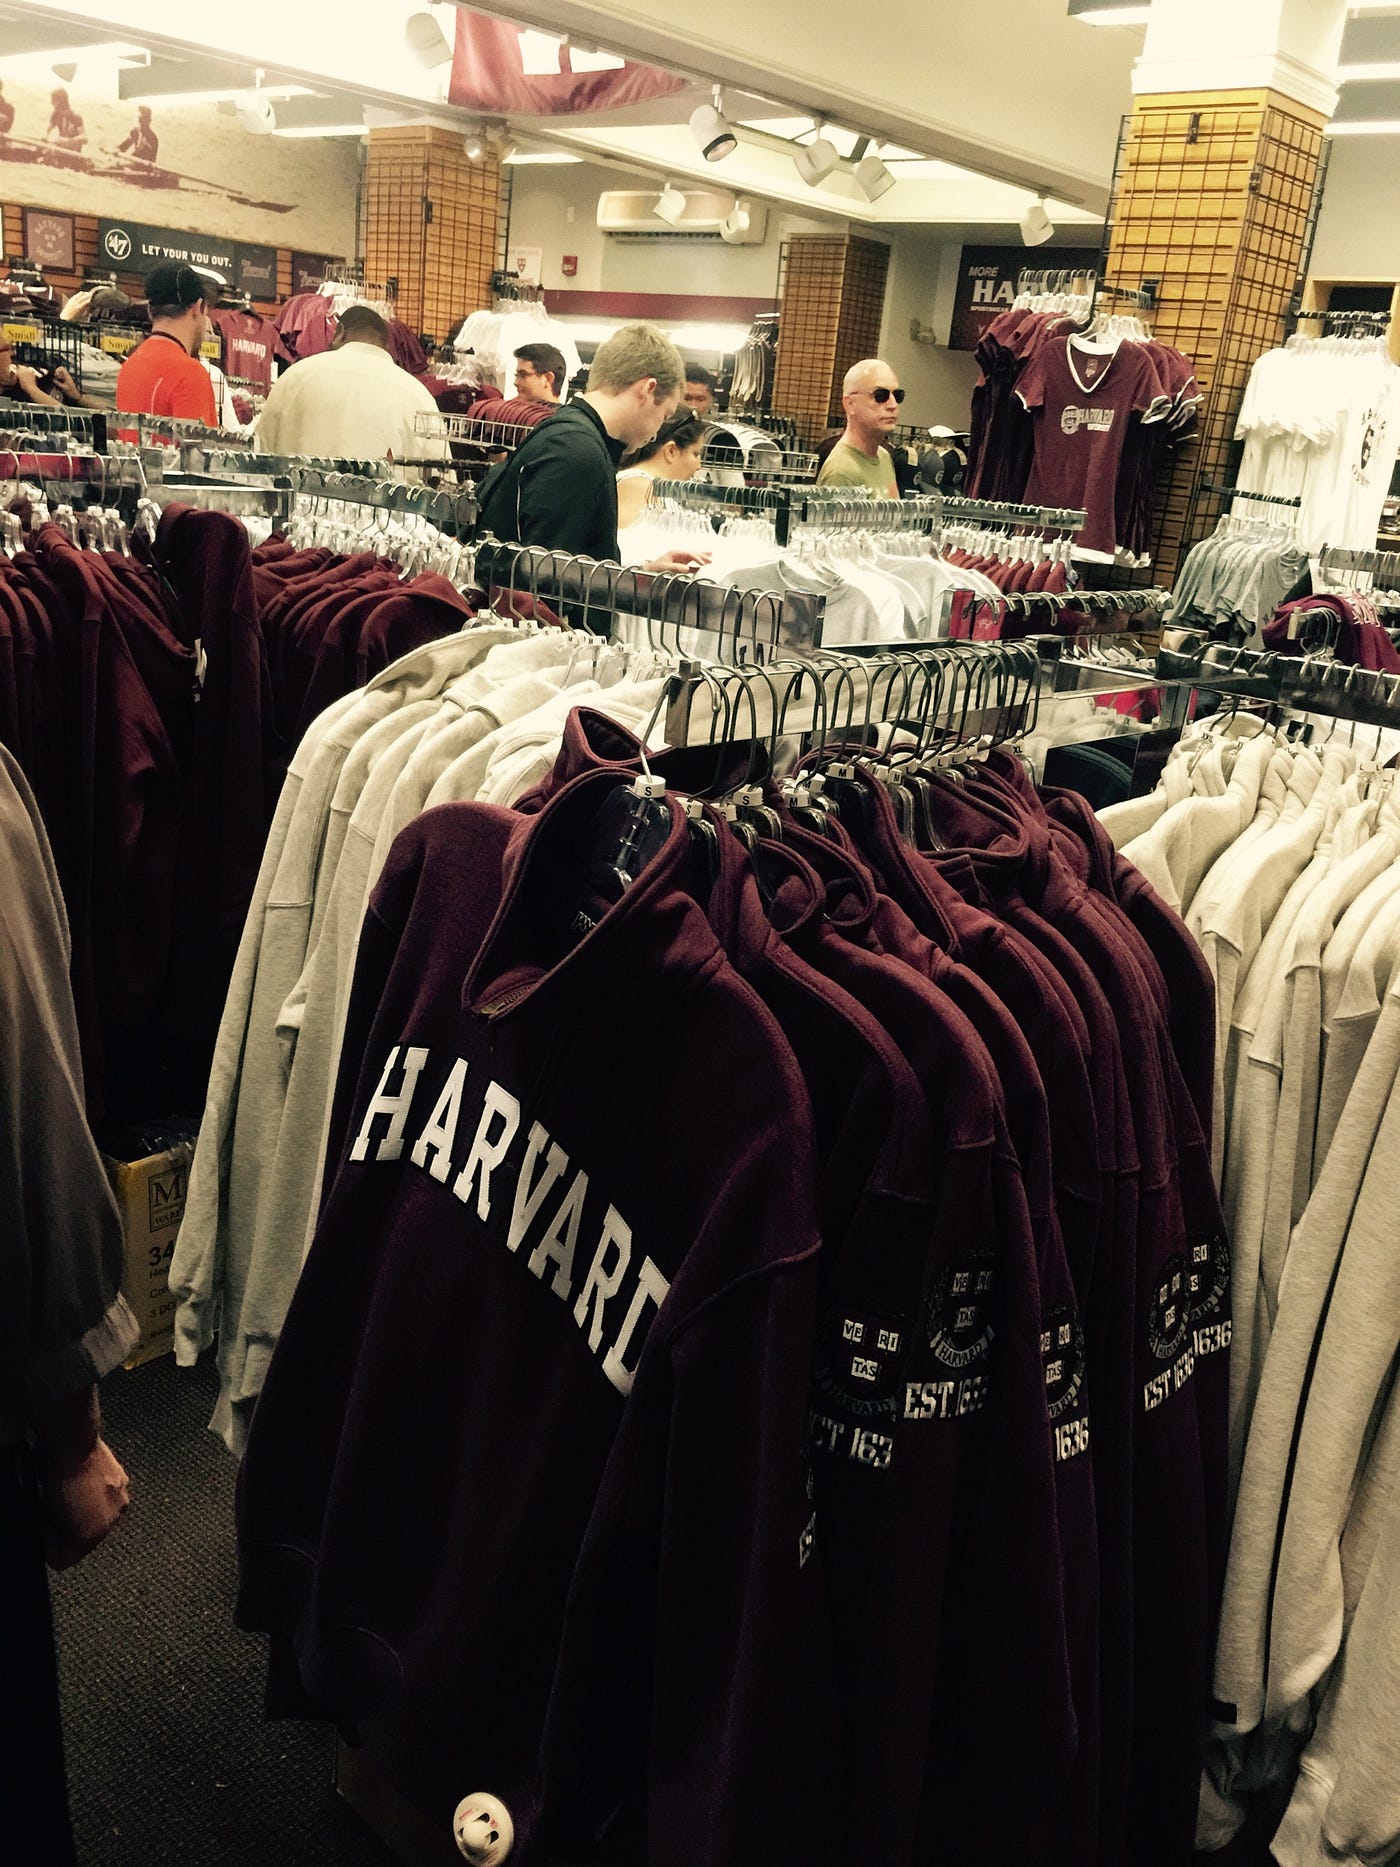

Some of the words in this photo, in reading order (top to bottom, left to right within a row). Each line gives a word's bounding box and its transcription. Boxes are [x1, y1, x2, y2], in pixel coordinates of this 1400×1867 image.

[142, 244, 161, 256] LET
[162, 247, 188, 261] YOUR
[190, 251, 209, 264] YOU
[968, 266, 999, 277] MORE
[8, 329, 36, 342] Small
[839, 768, 847, 778] M
[644, 786, 652, 796] S
[742, 795, 750, 805] S
[789, 797, 798, 806] M
[843, 1321, 864, 1342] VE
[877, 1330, 899, 1351] RI
[1193, 1319, 1232, 1358] 1636
[852, 1358, 878, 1380] TAS
[1144, 1369, 1172, 1412] EST
[1173, 1346, 1195, 1392] 1636
[1055, 1417, 1090, 1462] 1636
